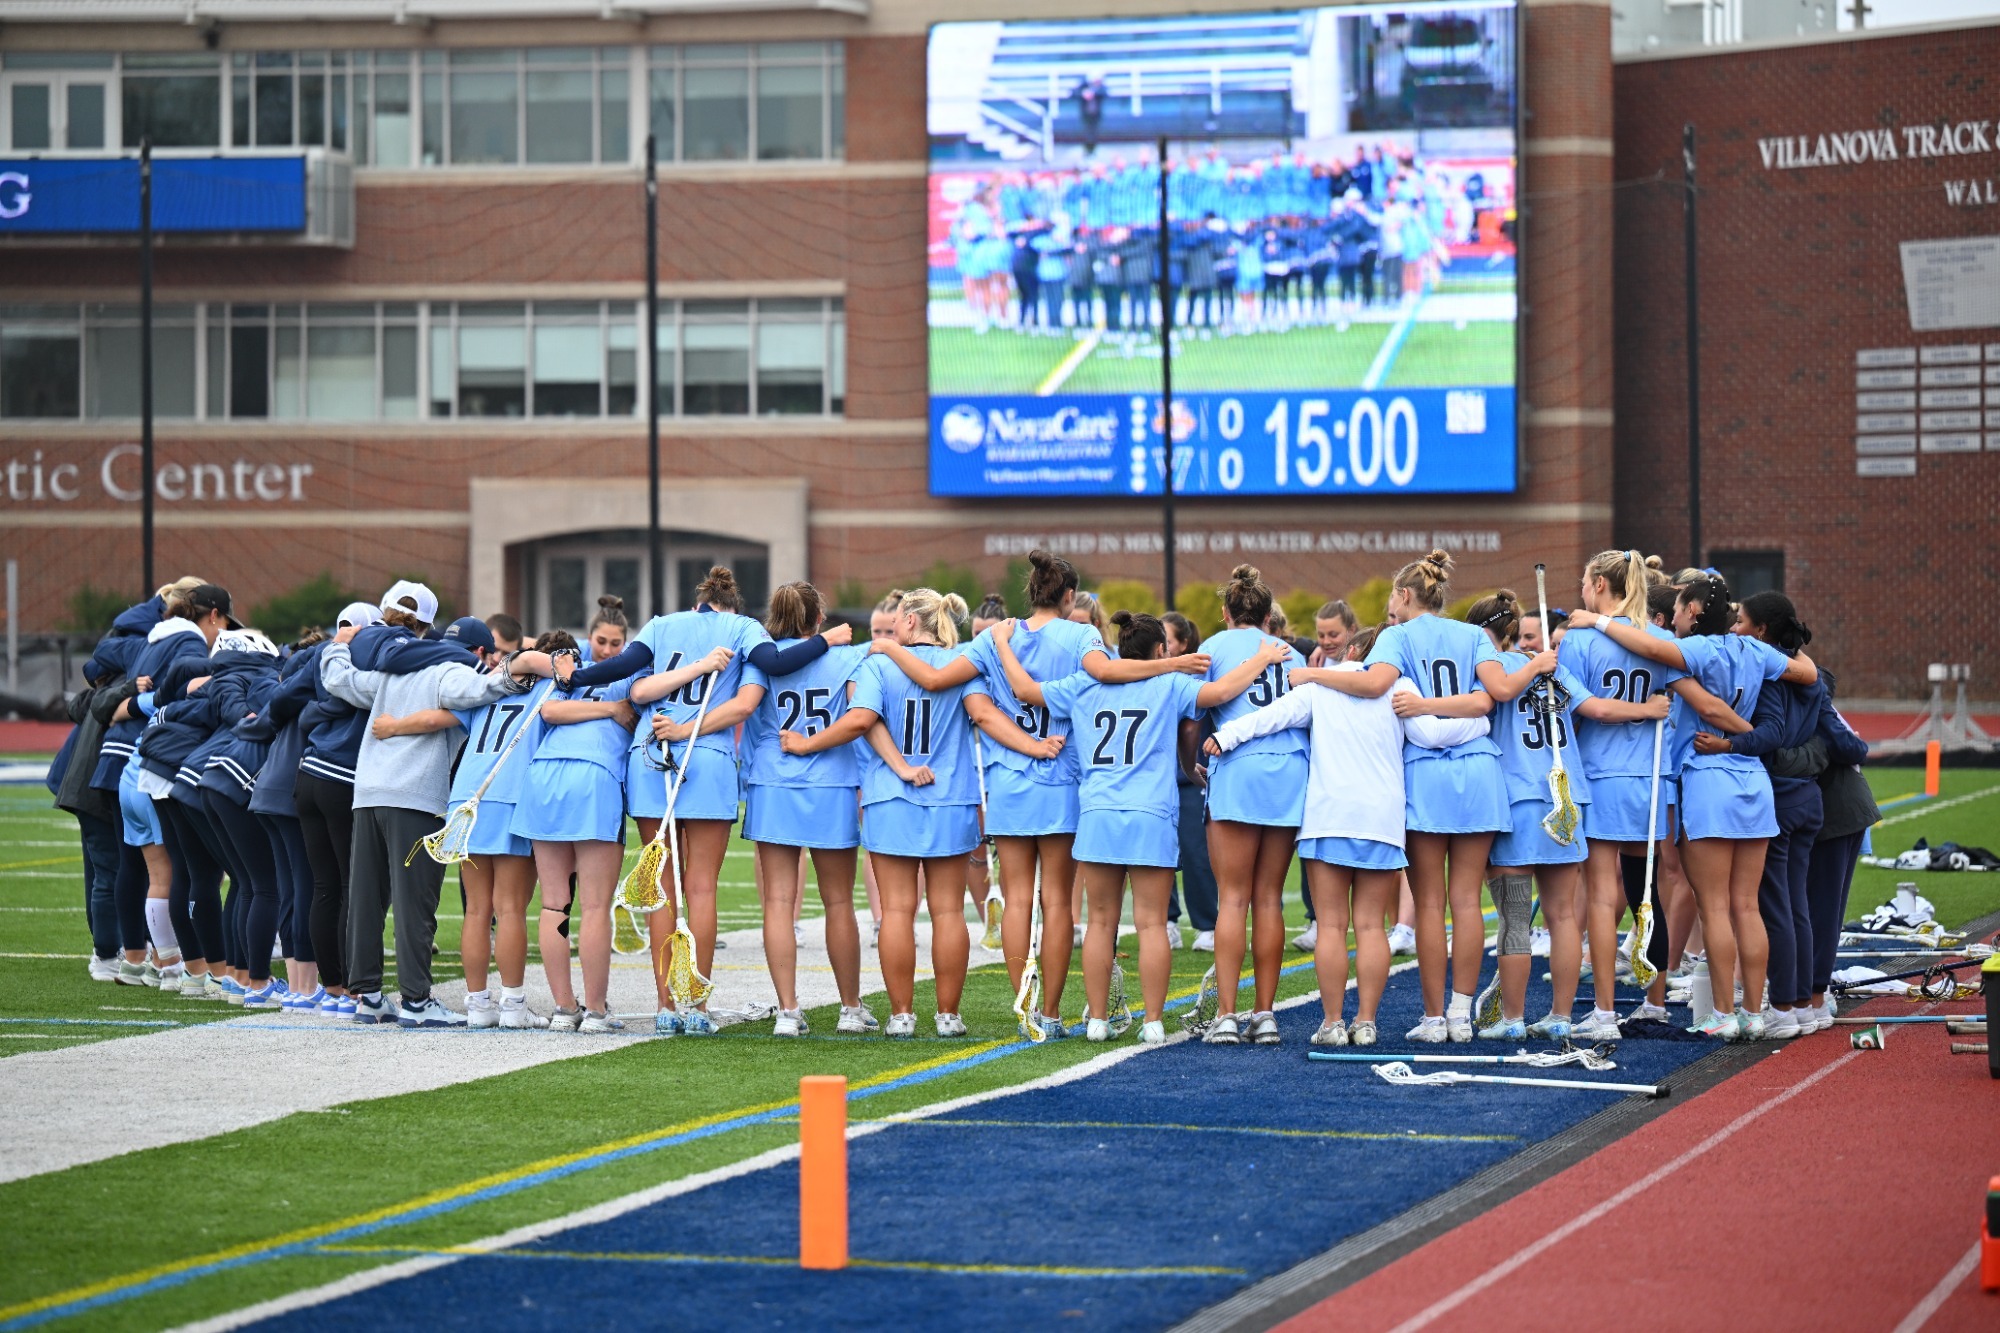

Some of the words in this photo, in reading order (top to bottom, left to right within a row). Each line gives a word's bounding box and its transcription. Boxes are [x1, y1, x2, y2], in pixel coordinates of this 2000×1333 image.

[1758, 129, 1899, 169] VILLANOVA
[1903, 121, 1990, 158] TRACK
[986, 406, 1119, 443] NovaCare
[1218, 398, 1244, 440] 0
[1265, 396, 1418, 486] 15:00
[101, 444, 314, 500] Center
[1218, 448, 1244, 490] 0
[777, 688, 832, 738] 25
[1601, 668, 1651, 726] 20
[474, 703, 526, 754] 17
[902, 698, 931, 756] 11
[1092, 709, 1149, 766] 27
